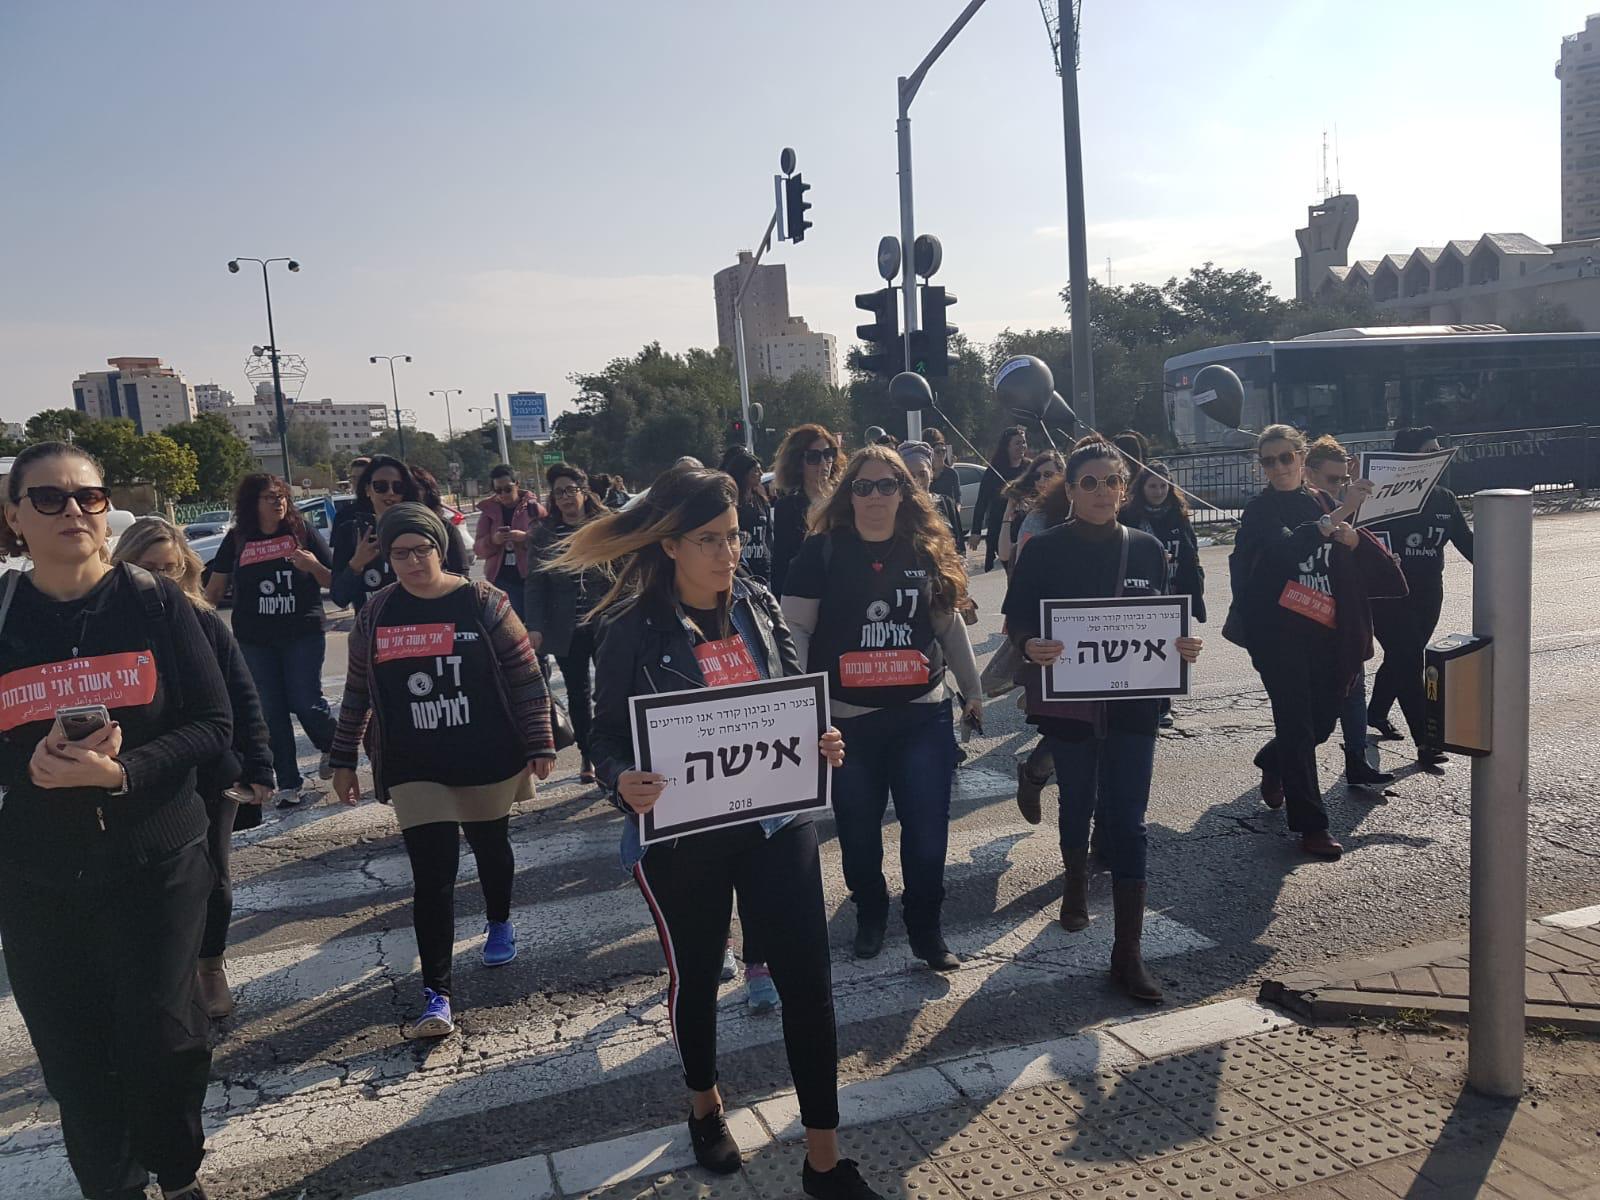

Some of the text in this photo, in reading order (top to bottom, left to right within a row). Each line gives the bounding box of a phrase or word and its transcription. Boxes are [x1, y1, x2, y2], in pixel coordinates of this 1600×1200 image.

[1376, 478, 1428, 499] אישה
[276, 570, 292, 590] די
[258, 592, 295, 614] לאלימות
[896, 589, 919, 618] די
[861, 620, 912, 648] לאלימות
[1077, 638, 1167, 664] אישה
[78, 671, 113, 693] אשה
[116, 669, 140, 686] אני
[436, 656, 462, 686] די
[51, 677, 75, 696] אני
[411, 690, 470, 729] לאלימות
[650, 698, 815, 728] בצער רב וביגון קודר אנו מודיעים
[719, 722, 759, 734] הירצחה
[762, 718, 775, 728] על
[684, 736, 801, 784] אישה
[729, 798, 752, 811] 2018
